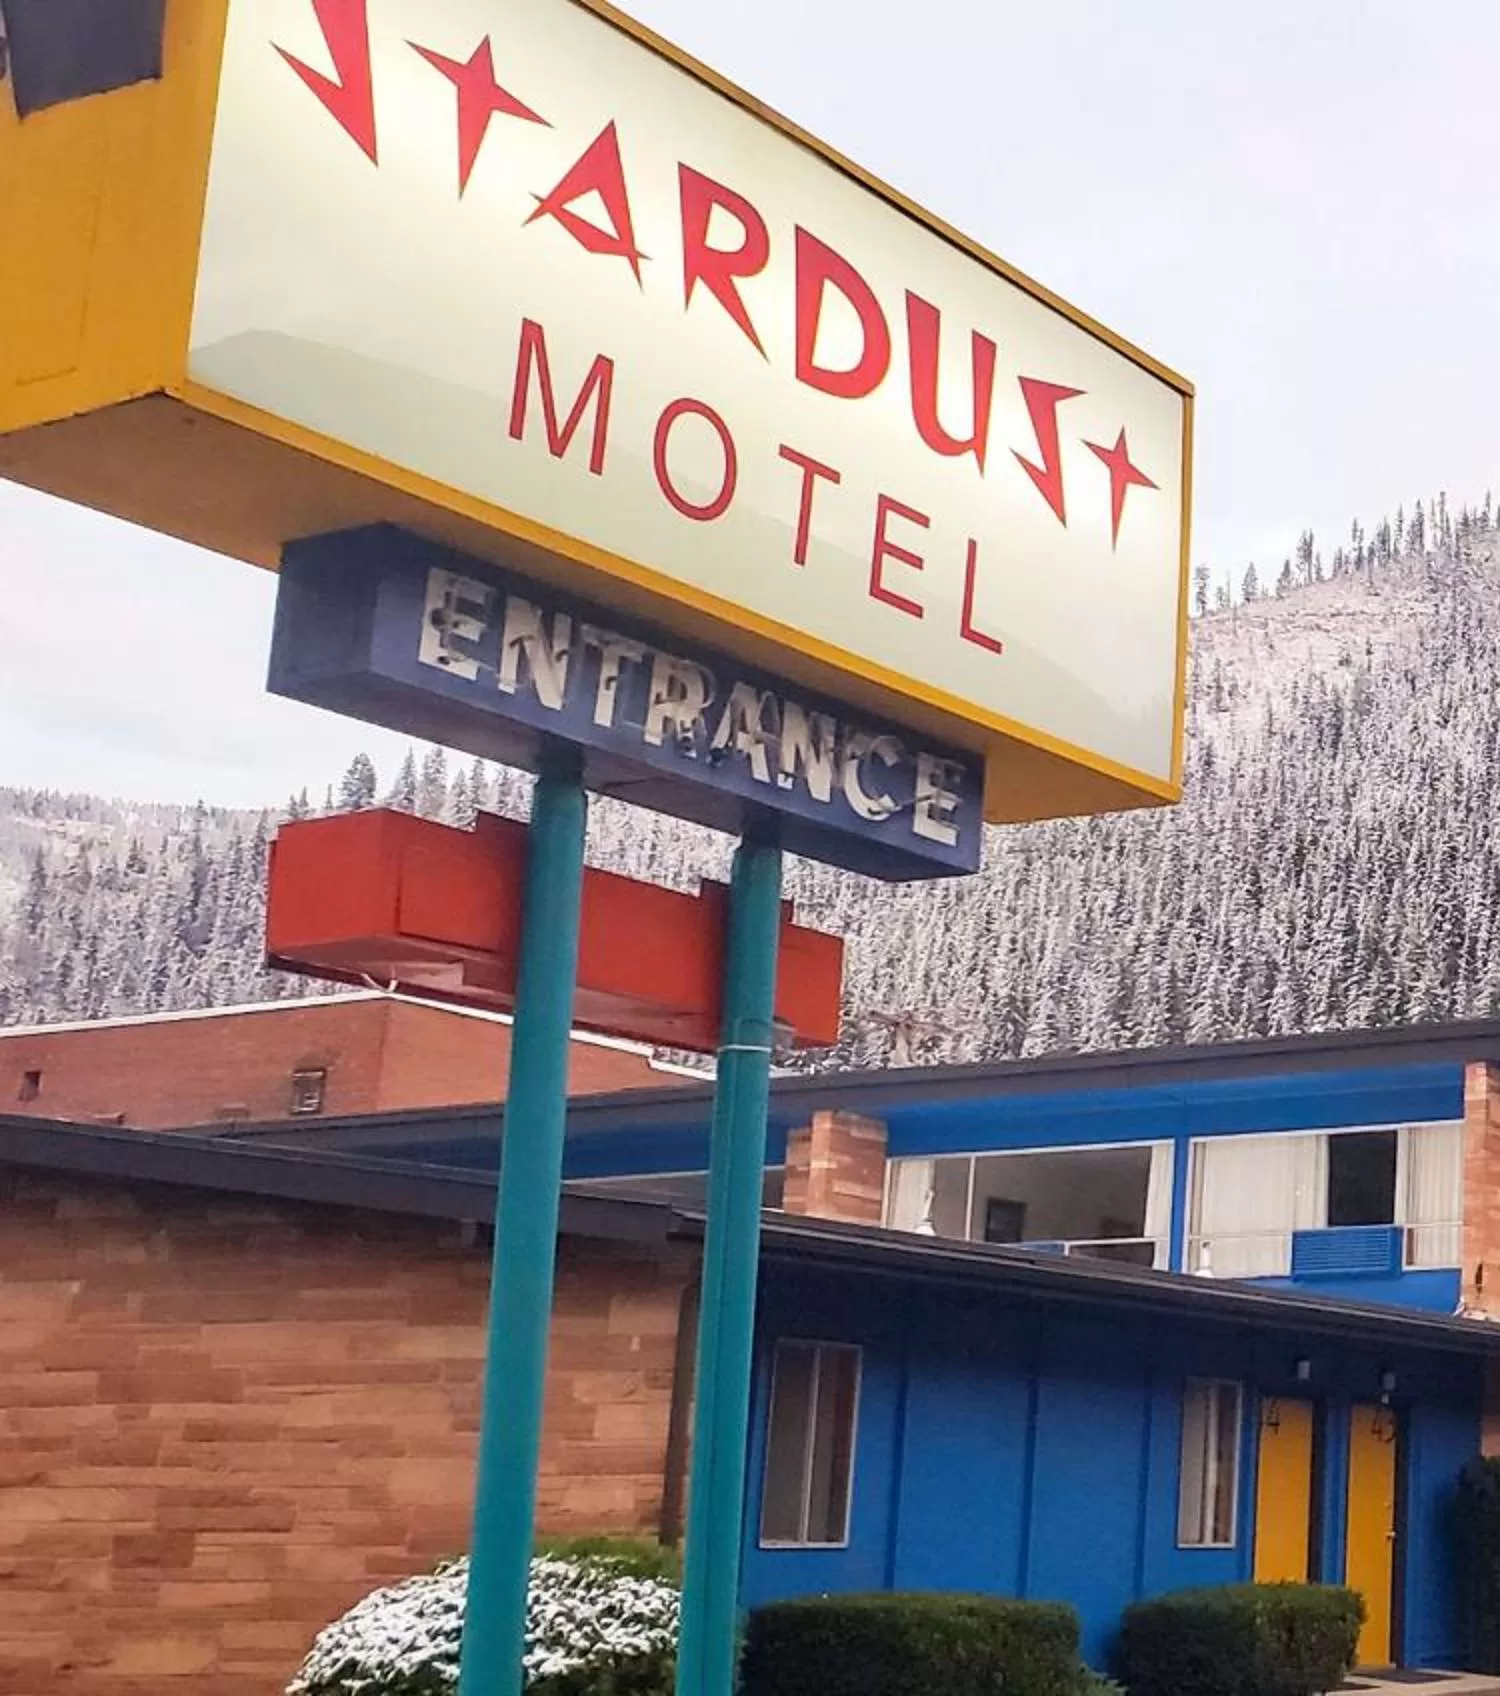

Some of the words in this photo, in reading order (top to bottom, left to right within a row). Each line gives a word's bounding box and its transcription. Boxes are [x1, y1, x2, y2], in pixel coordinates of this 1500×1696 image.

[268, 0, 1160, 553] STARDUST
[508, 317, 1003, 655] MOTEL
[417, 566, 966, 848] ENTRANCE
